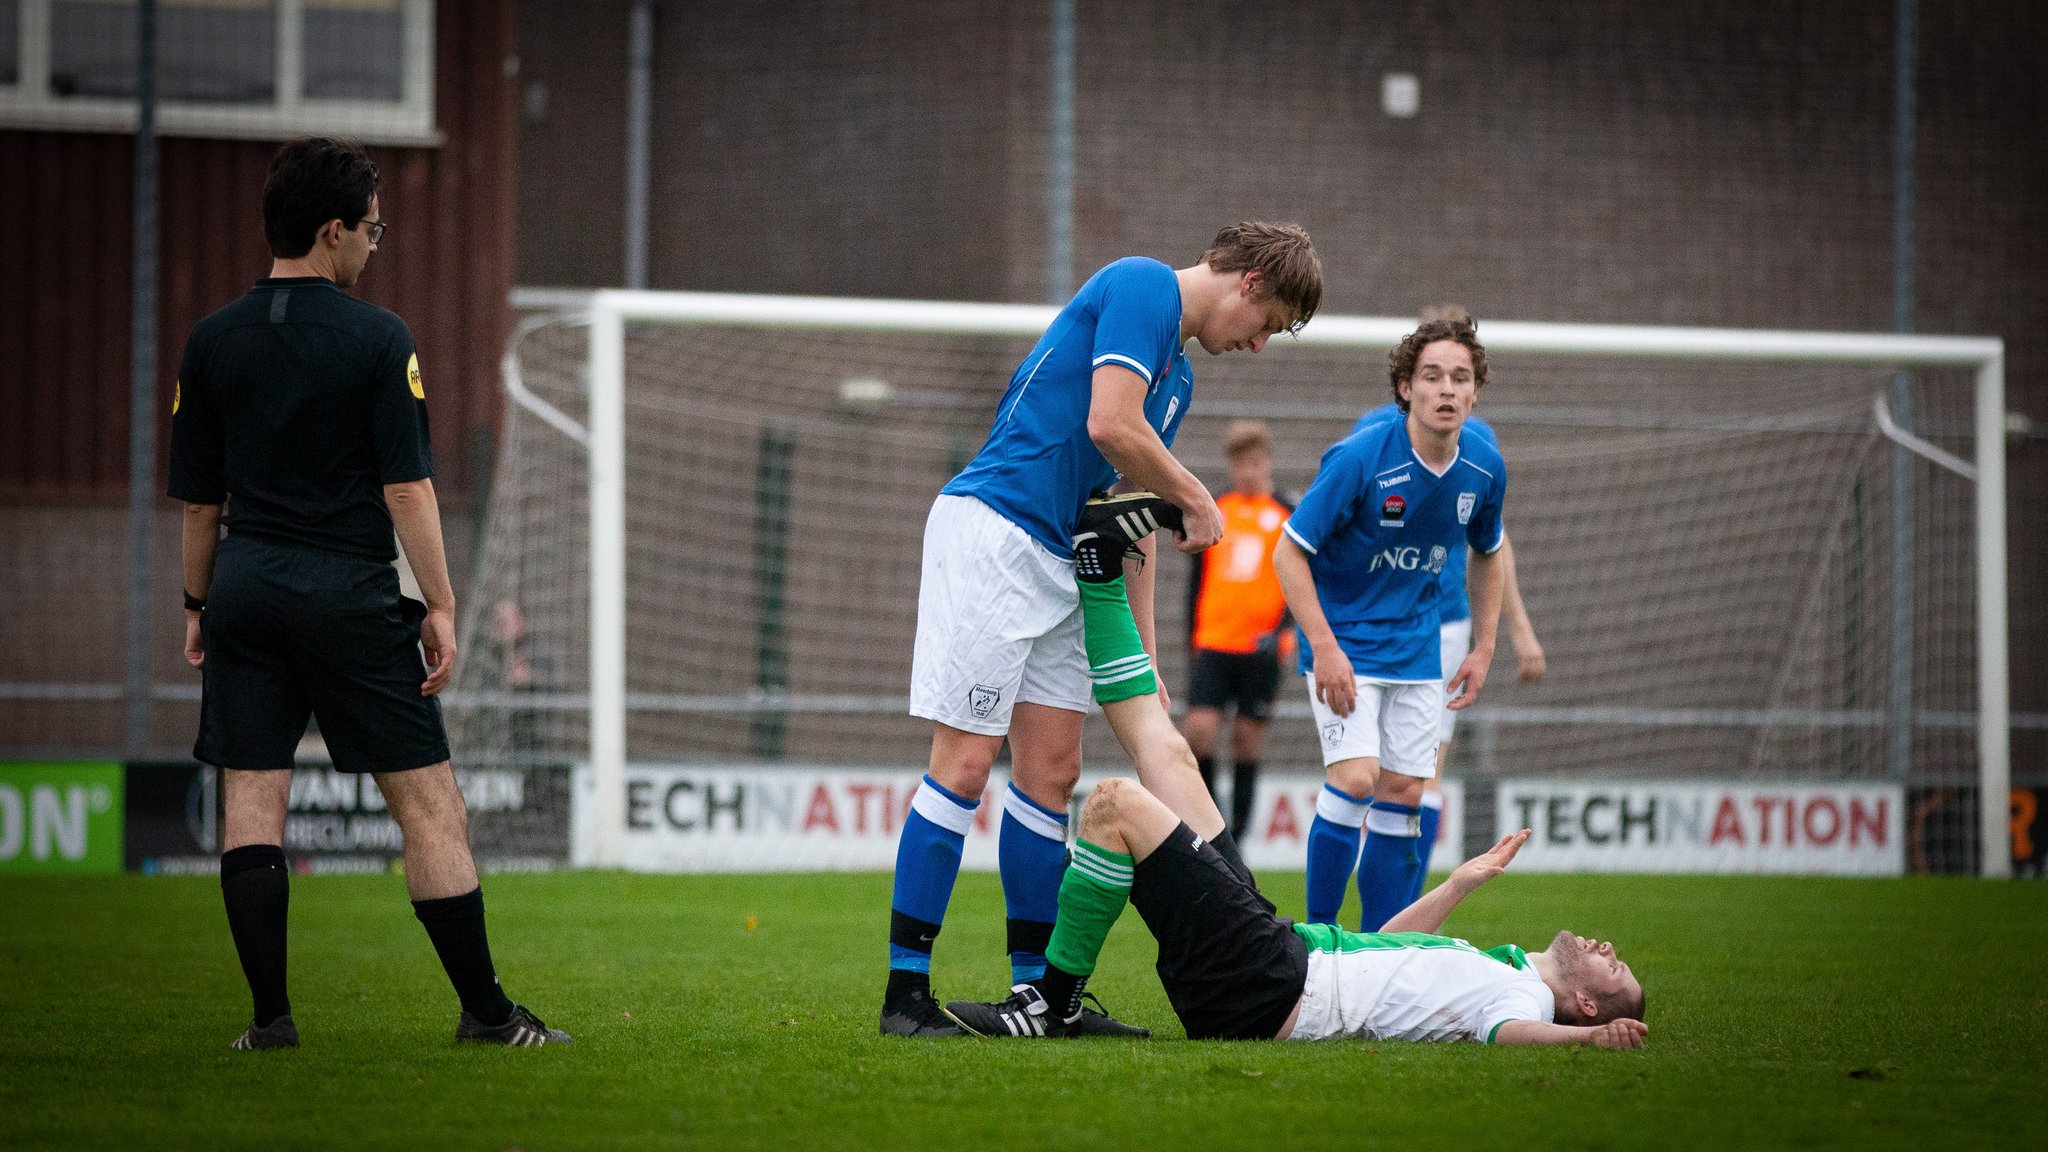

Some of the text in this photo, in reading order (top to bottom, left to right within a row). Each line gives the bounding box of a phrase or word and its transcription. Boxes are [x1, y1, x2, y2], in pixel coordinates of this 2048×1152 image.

[1379, 472, 1411, 489] hummel
[1366, 546, 1420, 573] ING
[1512, 794, 1889, 847] TECHNATION
